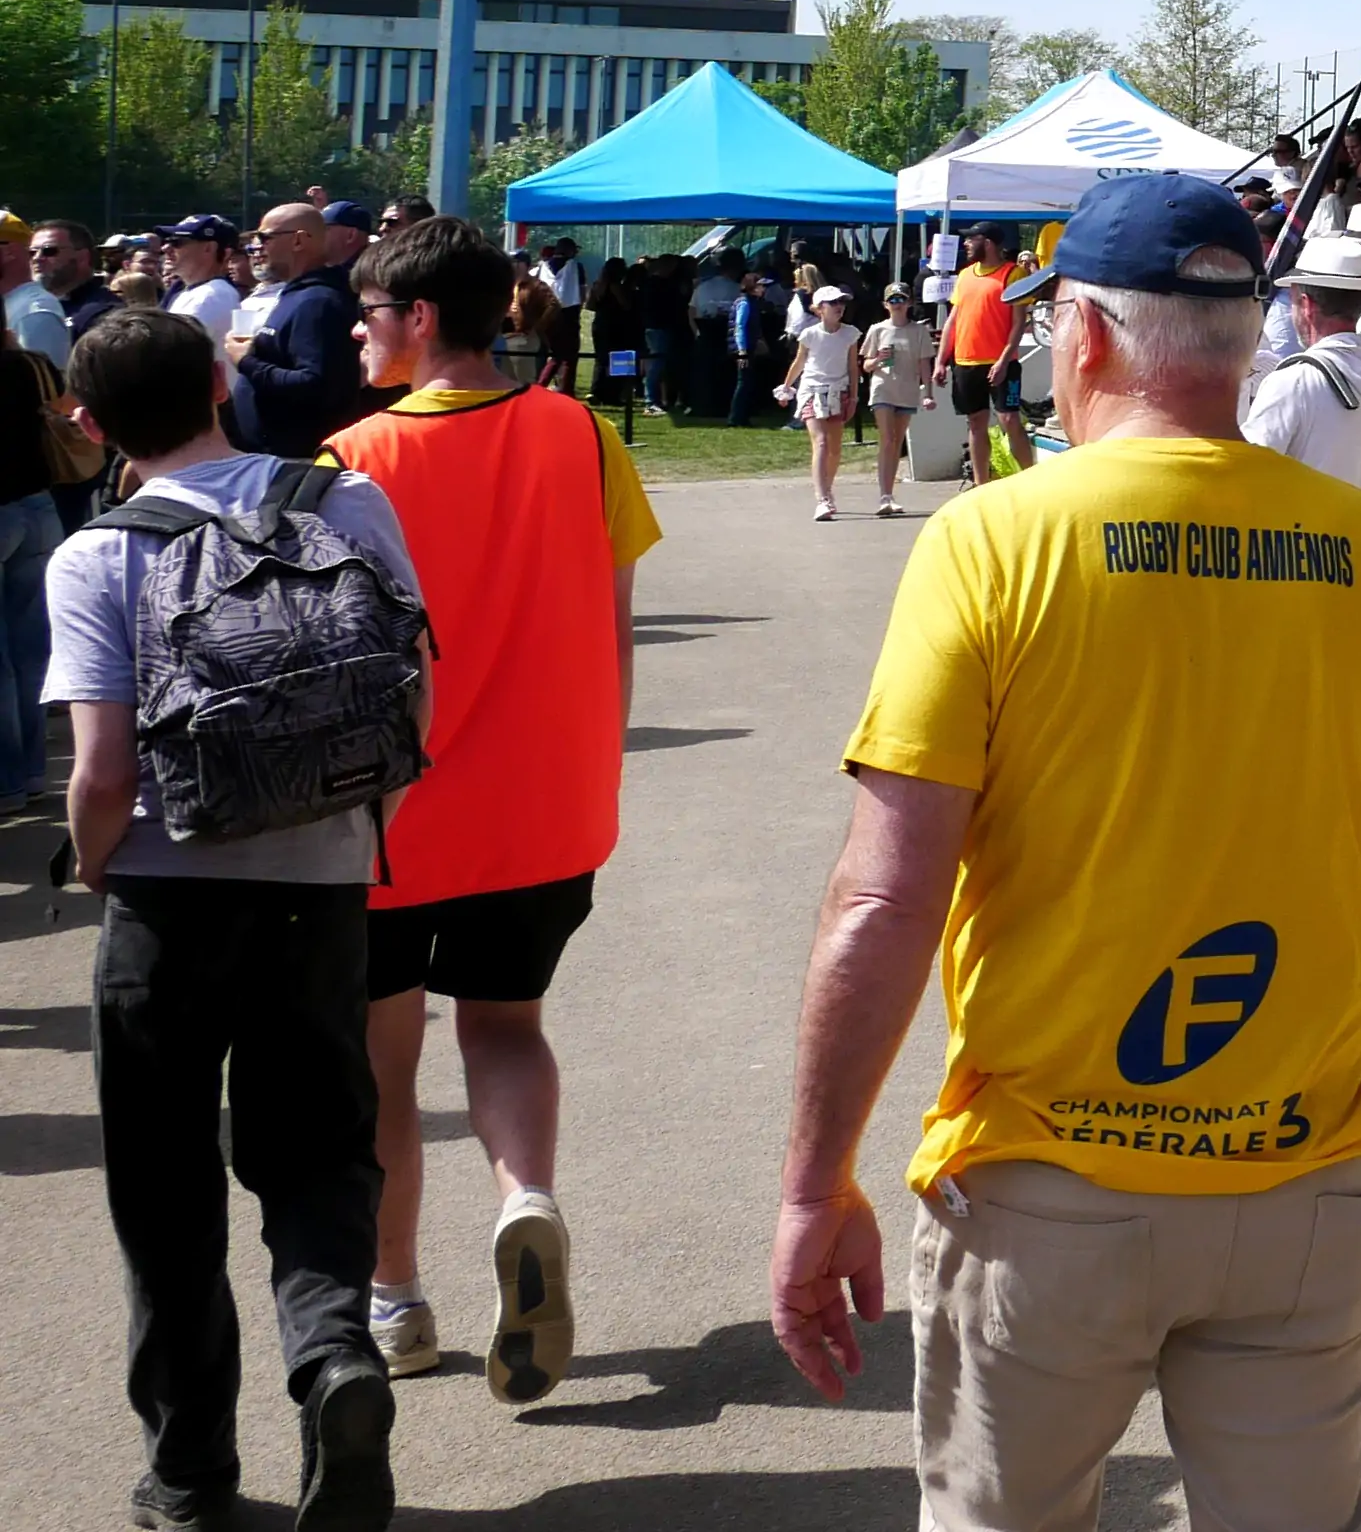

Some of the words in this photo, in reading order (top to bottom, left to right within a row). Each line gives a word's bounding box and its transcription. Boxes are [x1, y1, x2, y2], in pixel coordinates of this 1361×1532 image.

[1103, 520, 1180, 575] RUGBY
[1186, 521, 1241, 580] CLUB
[1246, 522, 1354, 588] AMIÉNOIS
[1048, 1098, 1271, 1127] CHAMPIONNAT
[1275, 1090, 1312, 1150] 3
